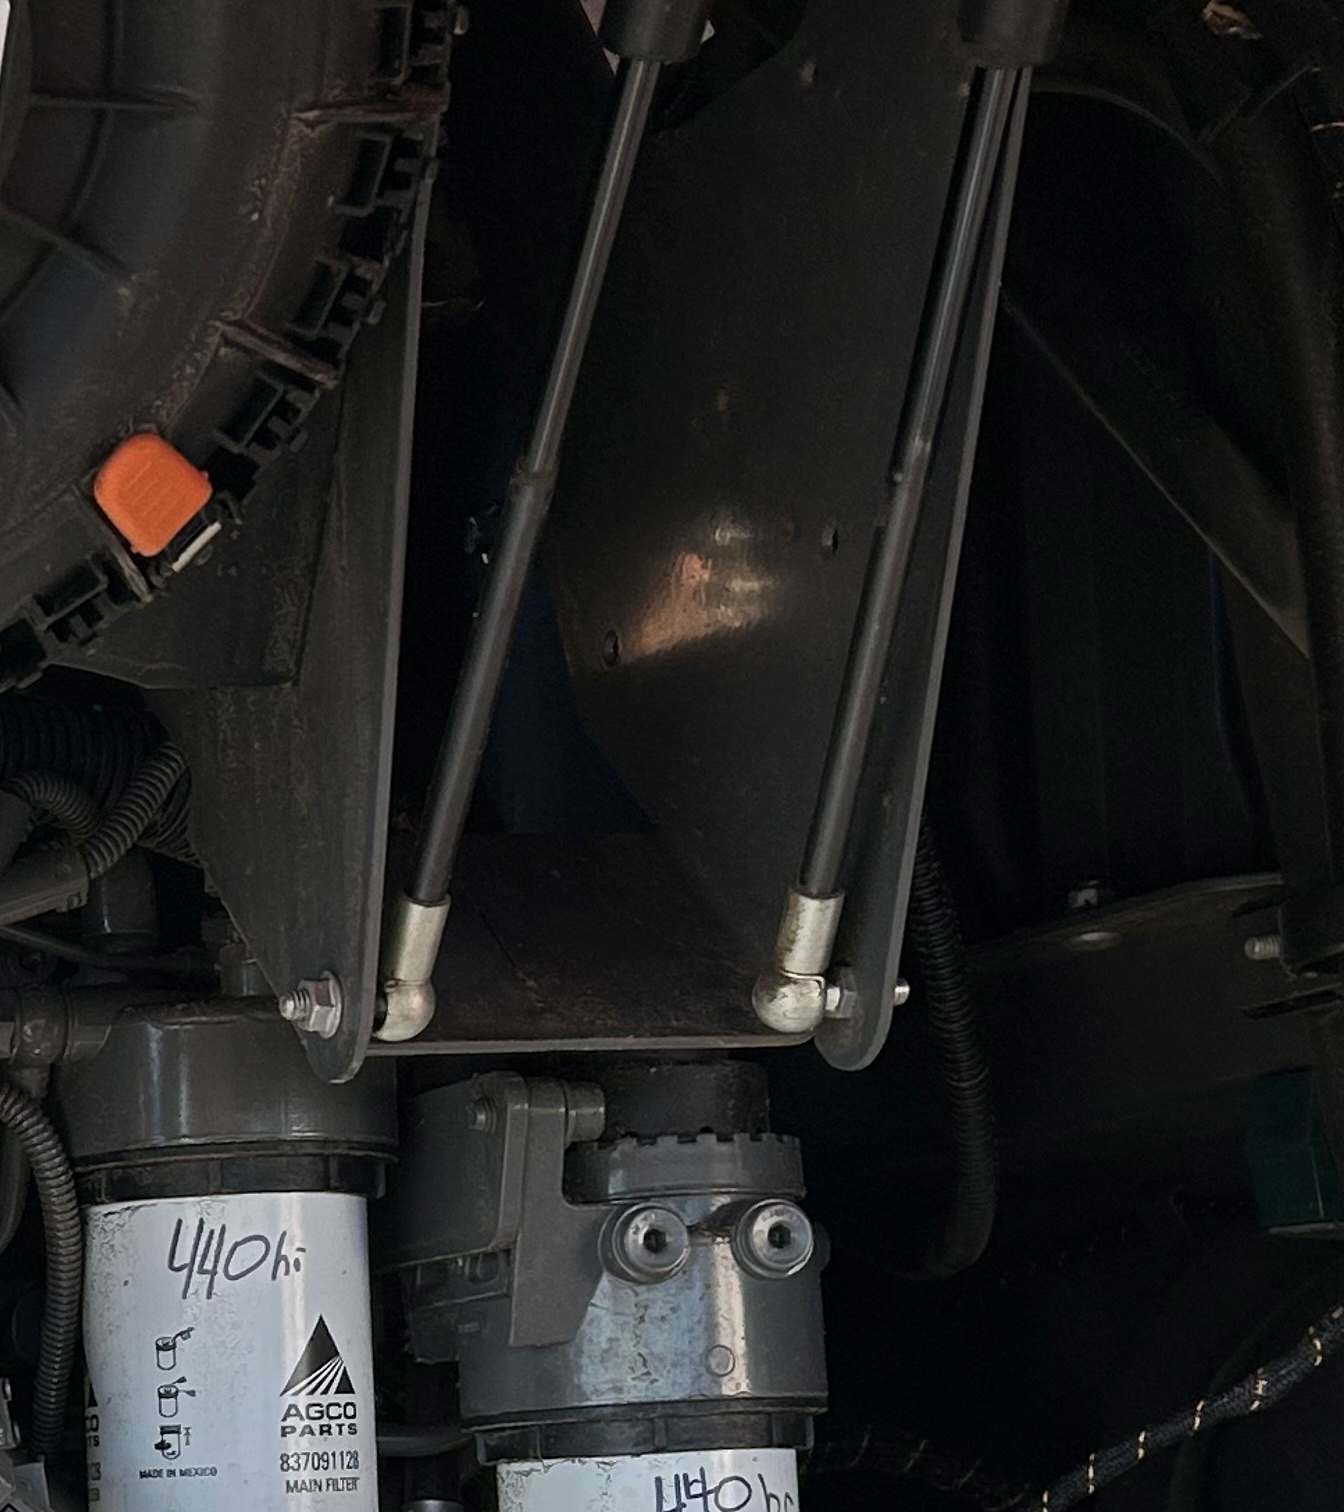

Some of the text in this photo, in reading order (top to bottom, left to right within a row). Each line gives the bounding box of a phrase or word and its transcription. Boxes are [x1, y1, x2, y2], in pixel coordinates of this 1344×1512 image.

[280, 1402, 357, 1422] AGCO
[280, 1423, 358, 1438] PARTS
[280, 1450, 360, 1472] 837091128
[139, 1469, 163, 1480] MADE
[179, 1467, 218, 1478] MEXICO
[286, 1479, 322, 1494] MAIN
